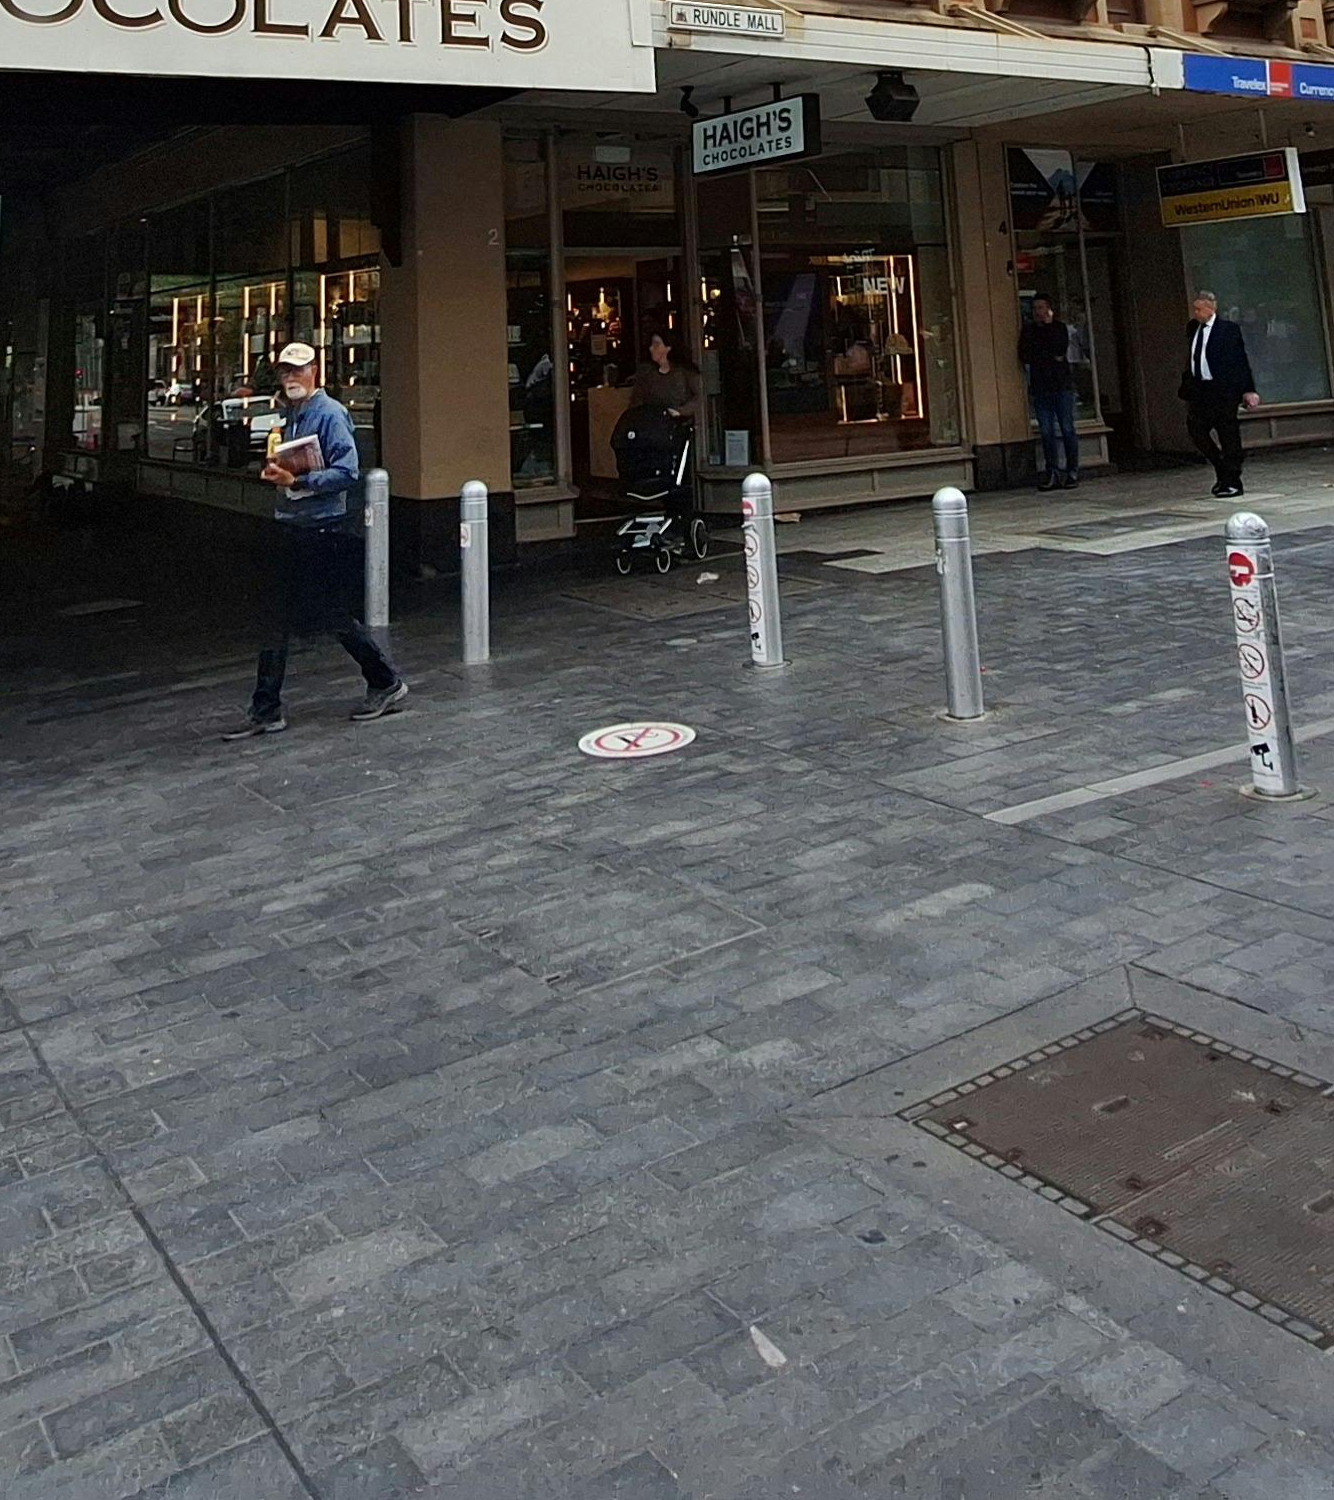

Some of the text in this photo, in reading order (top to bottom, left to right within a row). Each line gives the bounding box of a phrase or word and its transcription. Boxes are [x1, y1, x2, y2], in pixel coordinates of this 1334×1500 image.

[693, 9, 778, 31] RUNDLE MALL
[1231, 76, 1267, 90] Travelex
[703, 107, 792, 150] HAIGH'S
[703, 136, 793, 166] CHOCOLATES
[577, 165, 659, 182] HAIGH'S
[488, 228, 499, 246] 2
[863, 277, 905, 294] NEW
